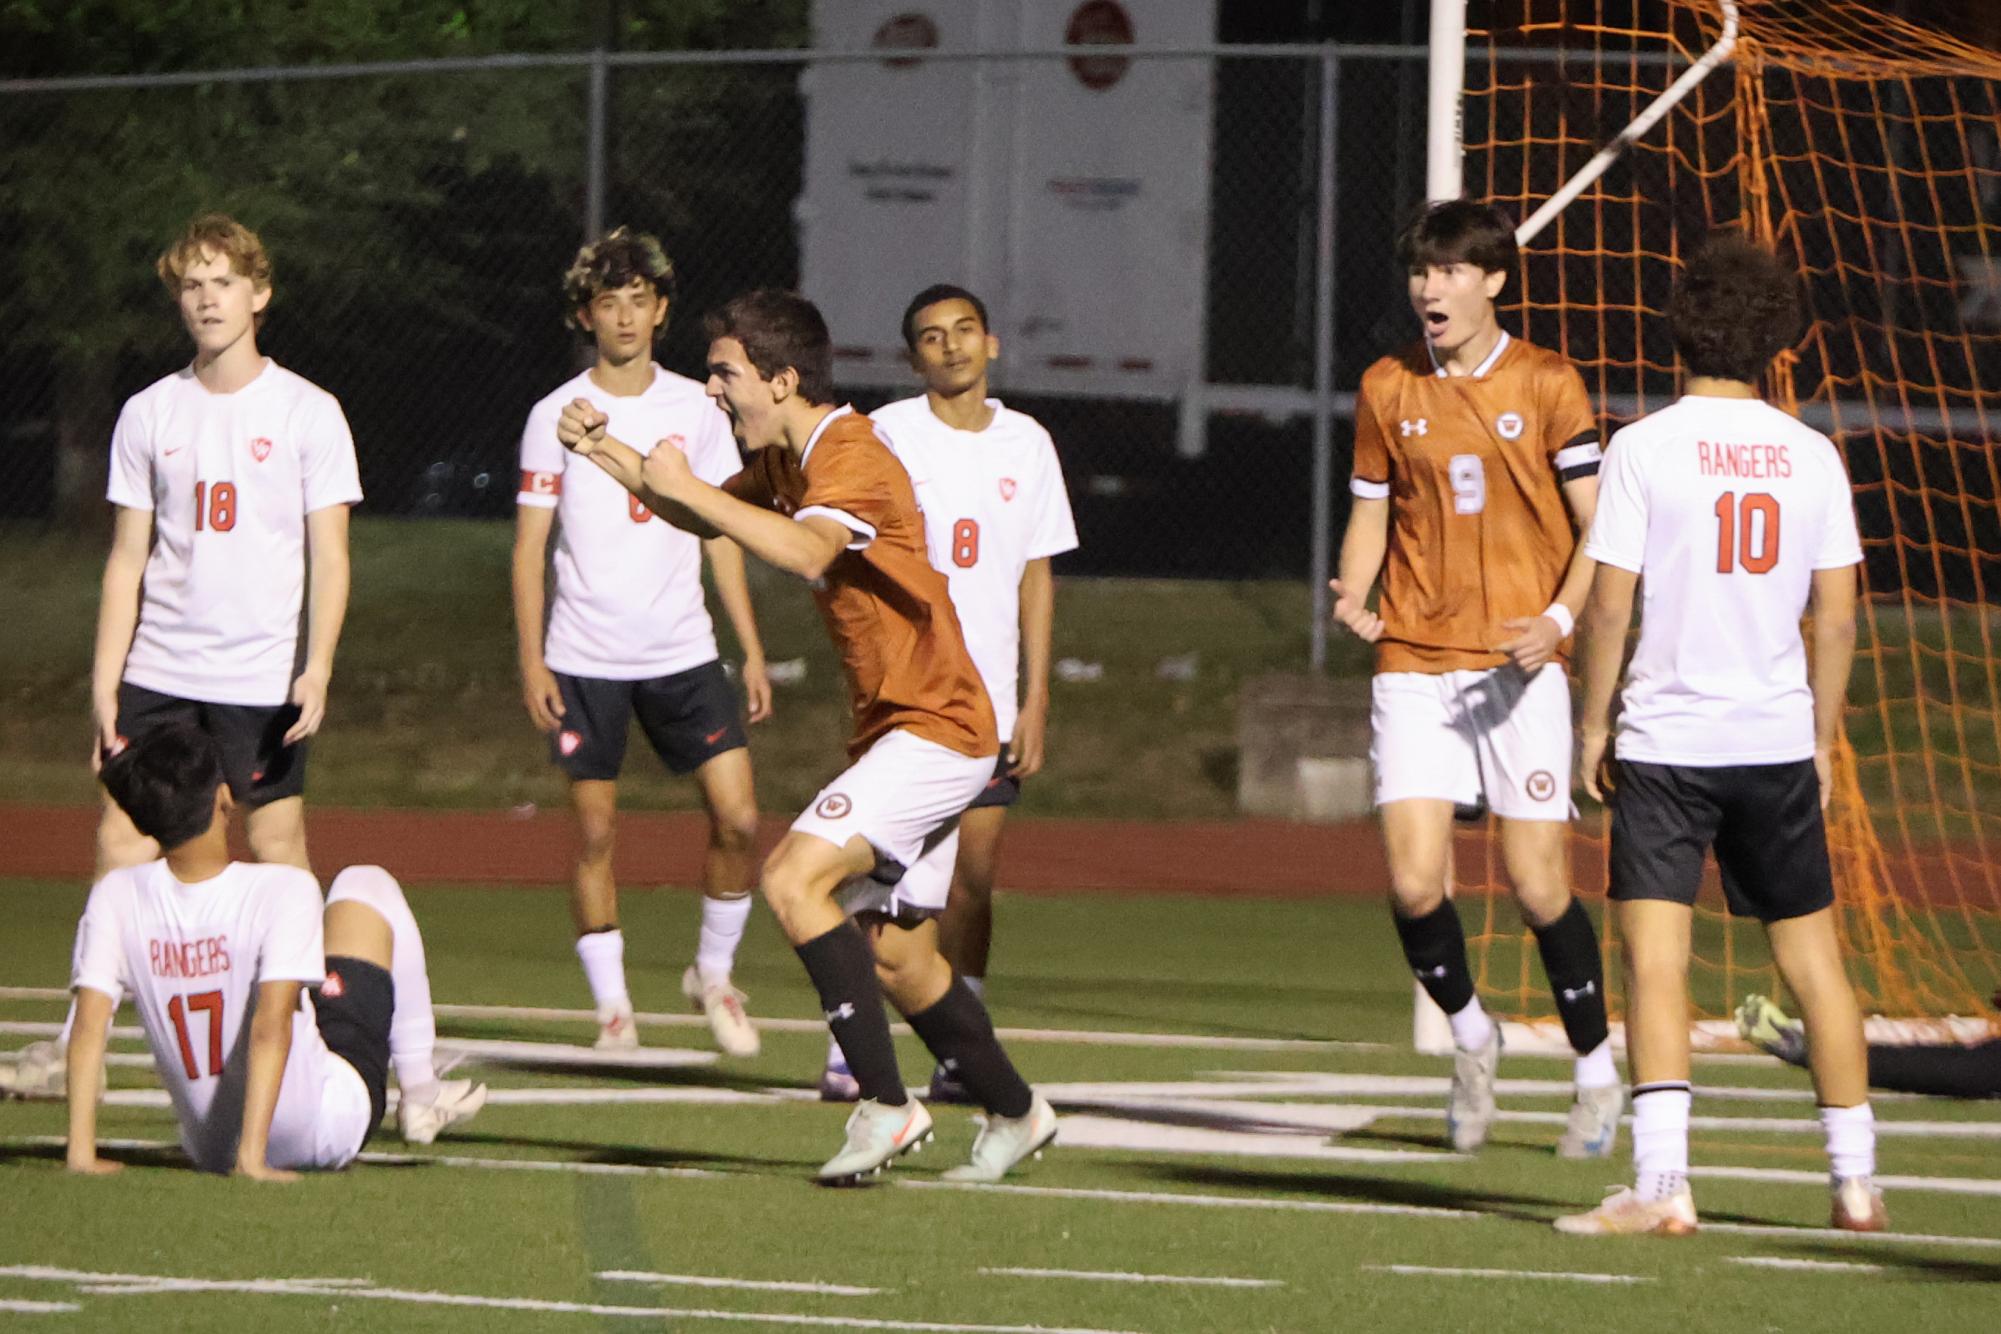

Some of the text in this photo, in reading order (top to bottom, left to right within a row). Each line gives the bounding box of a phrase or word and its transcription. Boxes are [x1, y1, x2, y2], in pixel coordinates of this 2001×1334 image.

[532, 472, 554, 493] C
[1449, 454, 1485, 515] 9
[1697, 441, 1792, 479] RANGERS
[194, 480, 237, 532] 18
[952, 518, 980, 568] 8
[1715, 491, 1781, 574] 10
[150, 935, 231, 978] RANGERS
[168, 990, 225, 1080] 17
